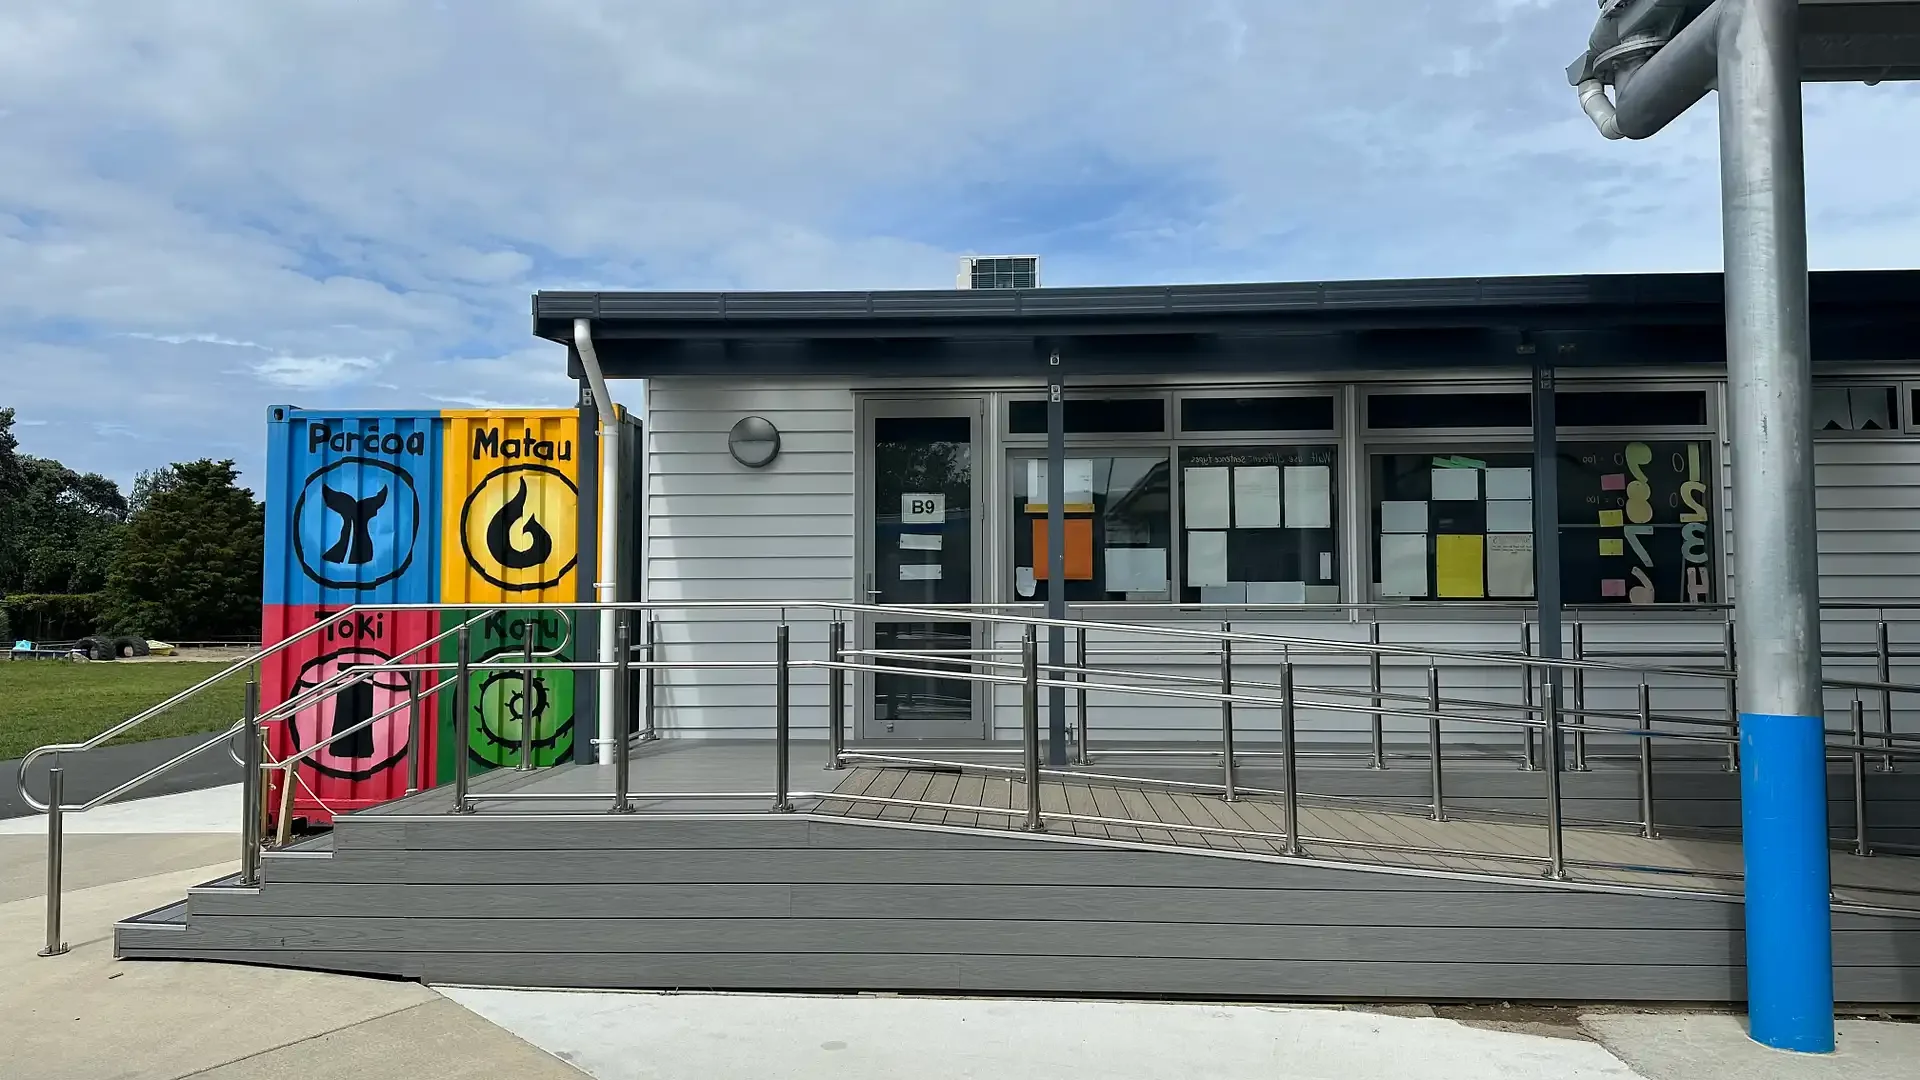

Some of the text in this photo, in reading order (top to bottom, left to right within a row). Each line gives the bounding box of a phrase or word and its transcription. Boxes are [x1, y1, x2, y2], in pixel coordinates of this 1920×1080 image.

[473, 427, 572, 461] Matau
[911, 499, 935, 515] B9
[314, 610, 384, 641] Toki
